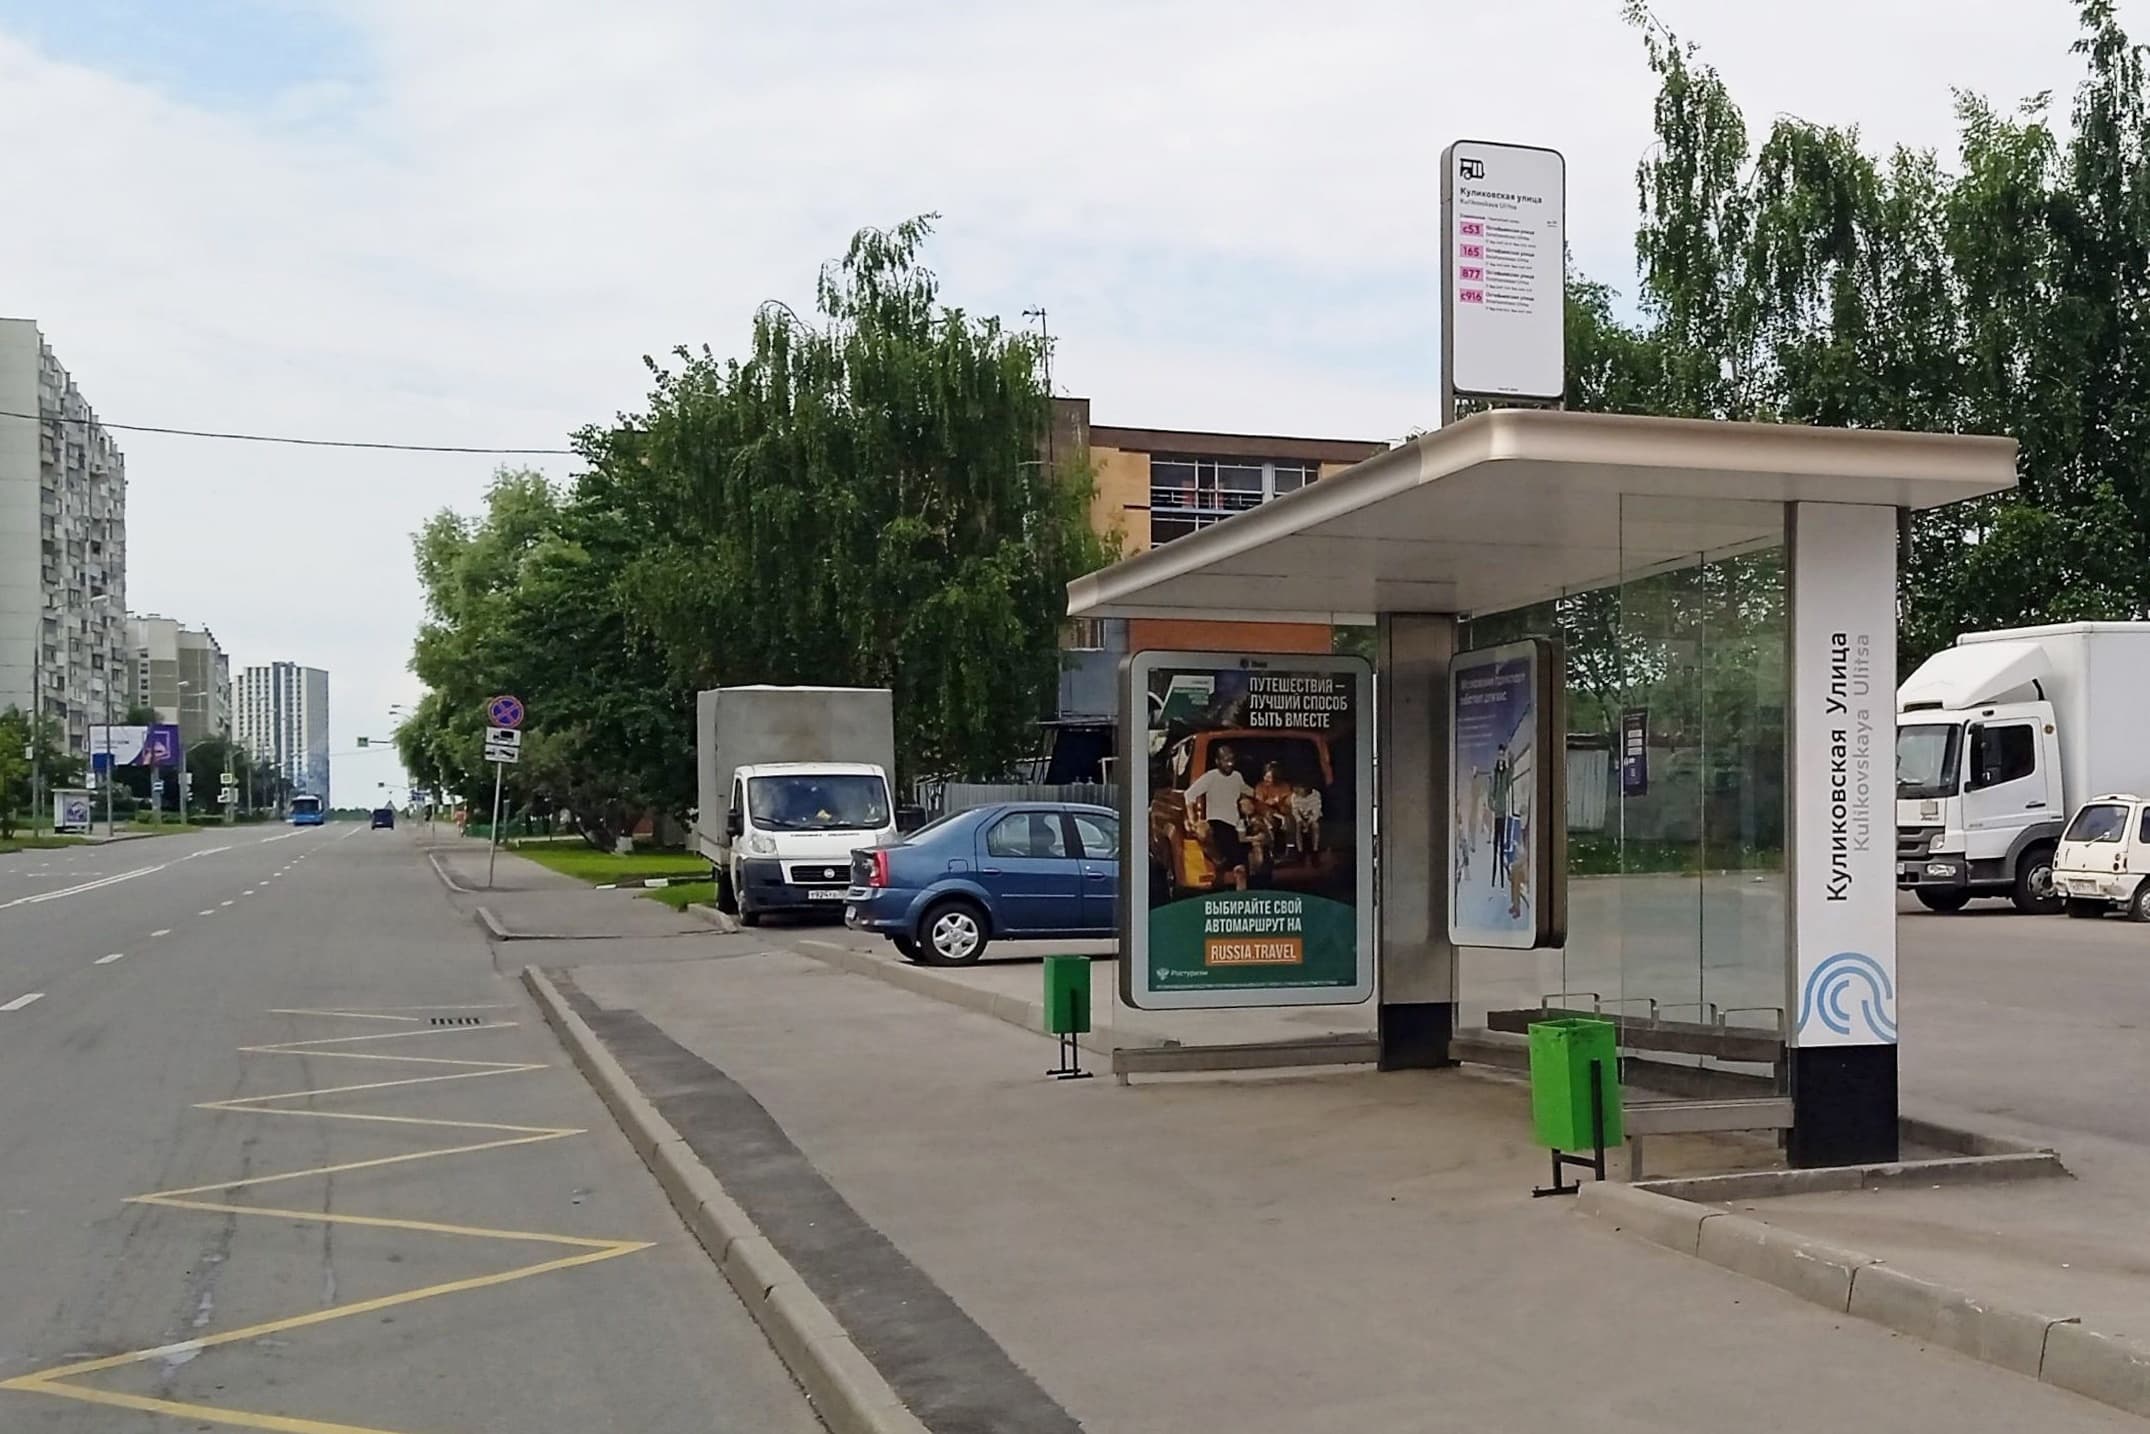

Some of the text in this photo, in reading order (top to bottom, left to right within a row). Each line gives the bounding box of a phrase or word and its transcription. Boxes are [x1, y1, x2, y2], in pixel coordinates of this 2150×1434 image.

[1460, 187, 1516, 200] Куликовская
[1463, 246, 1480, 257] 165
[1250, 677, 1333, 693] ПУТЕШЕСТВИЯ
[1250, 693, 1348, 711] ЛУЧШИЙ СПОСОБ
[1250, 711, 1330, 728] БЫТЬ ВМЕСТЕ
[1852, 635, 1873, 851] Kulikovskaya Ulitsa
[1826, 633, 1852, 901] Куликовская Улица
[1205, 897, 1302, 915] ВЫБИРАЙТЕ СВОЙ
[1205, 917, 1302, 933] АВТОМАРШРУТ НА
[1211, 943, 1296, 960] RUSSIA.TRAVEL
